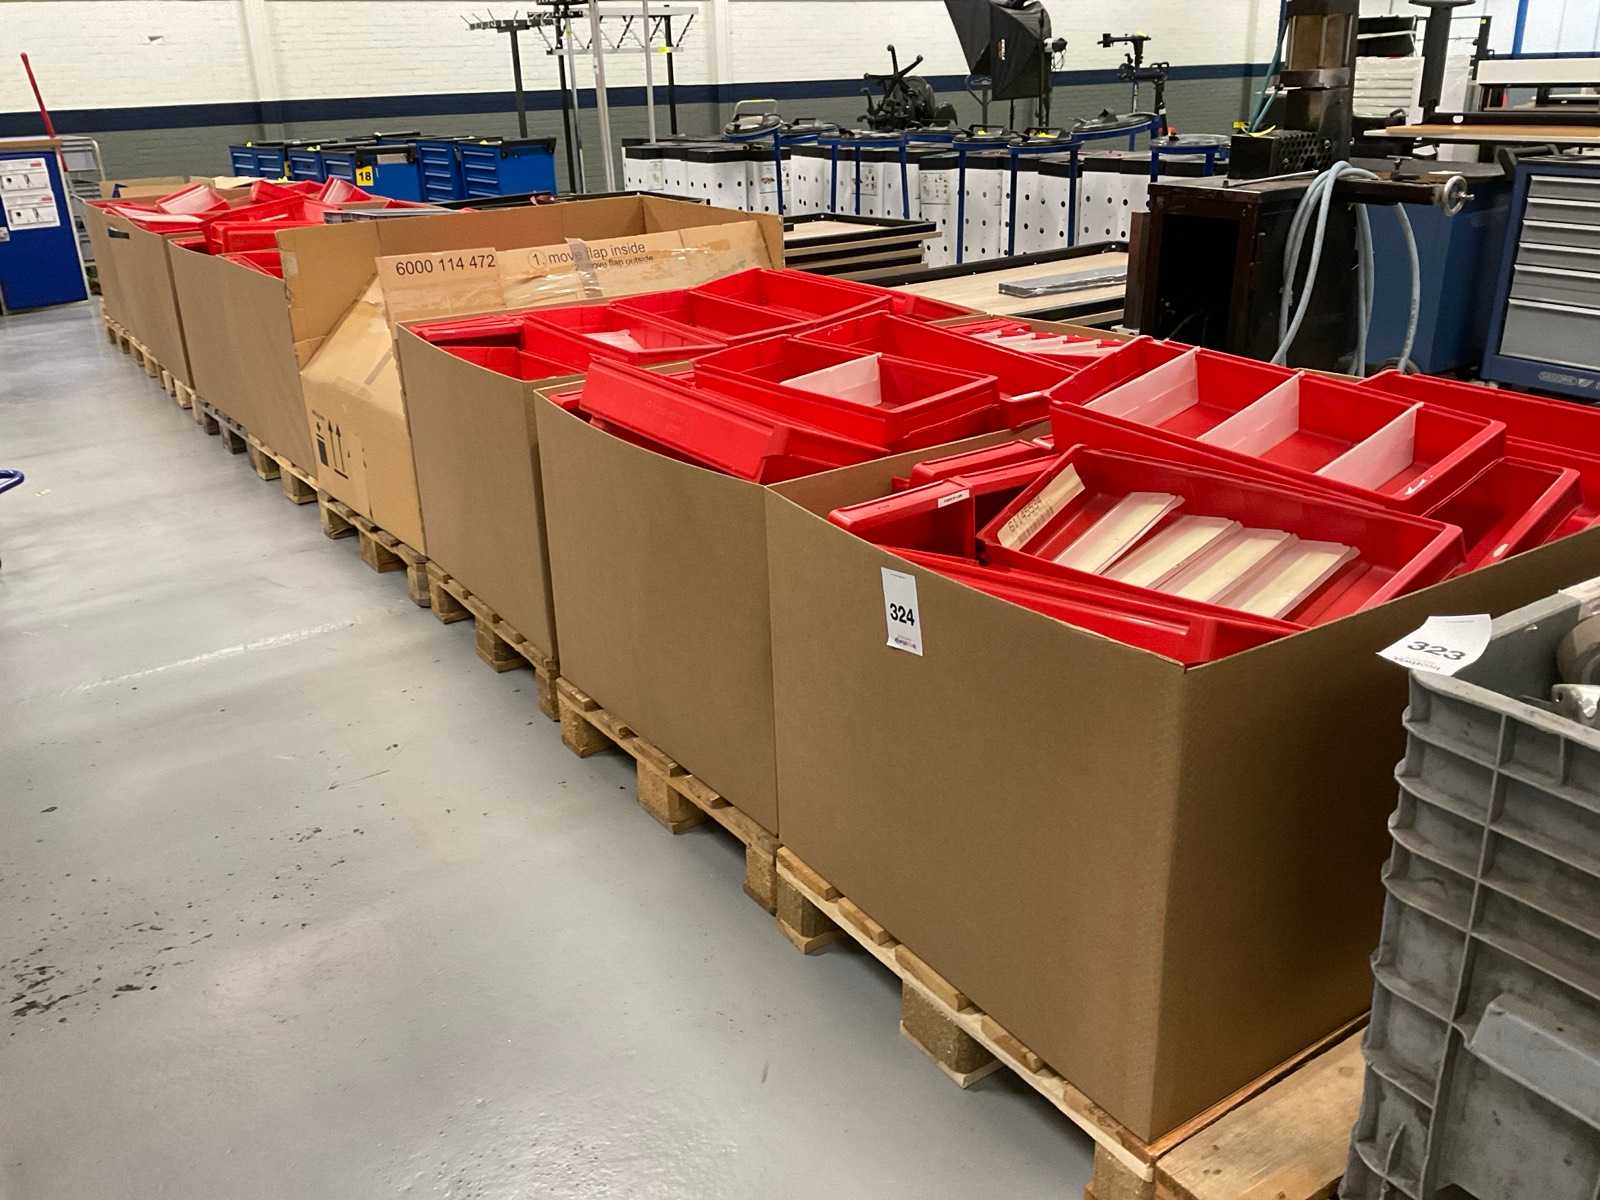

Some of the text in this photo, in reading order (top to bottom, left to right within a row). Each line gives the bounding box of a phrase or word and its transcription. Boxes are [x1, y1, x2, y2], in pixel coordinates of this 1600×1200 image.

[358, 171, 372, 182] 18
[610, 242, 646, 257] inside
[395, 254, 496, 276] 6000 114 472
[889, 602, 915, 627] 324
[1407, 641, 1467, 661] 323
